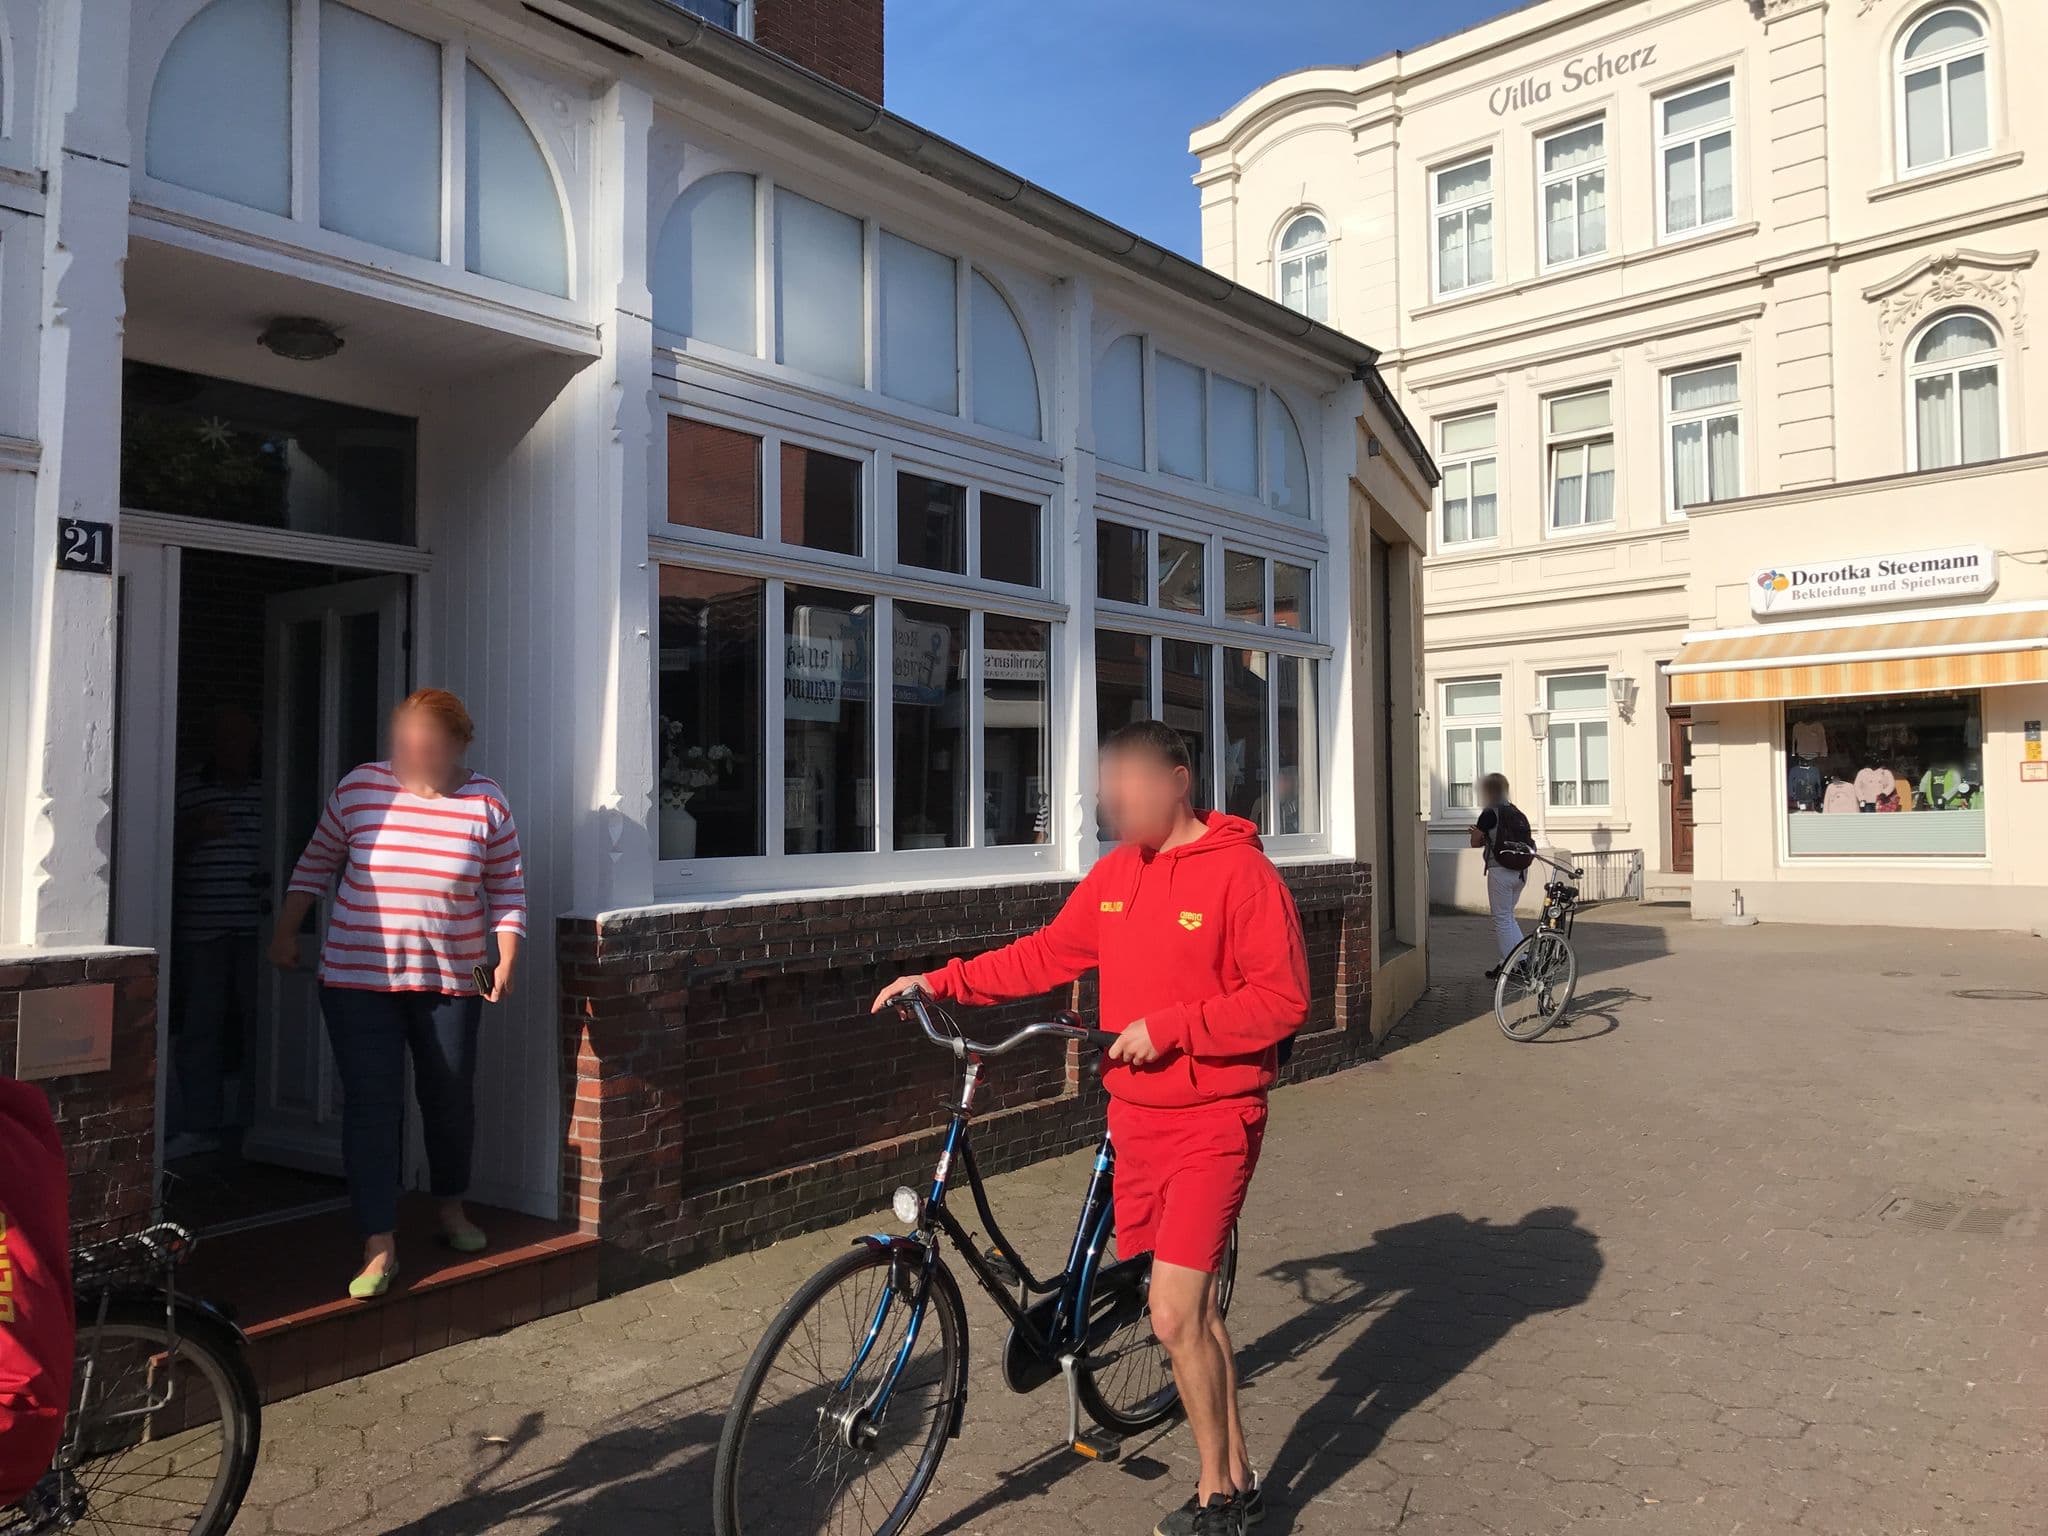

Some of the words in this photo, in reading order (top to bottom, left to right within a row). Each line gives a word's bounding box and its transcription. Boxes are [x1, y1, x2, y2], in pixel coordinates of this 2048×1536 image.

[1489, 76, 1551, 116] Villa
[1562, 44, 1657, 93] Scherz
[65, 527, 104, 564] 21
[1791, 564, 1871, 586] Dorotka
[1878, 554, 1979, 577] Steemann
[1791, 585, 1867, 601] Bekleidung
[1870, 580, 1896, 593] und
[1901, 573, 1980, 592] Spielwaren
